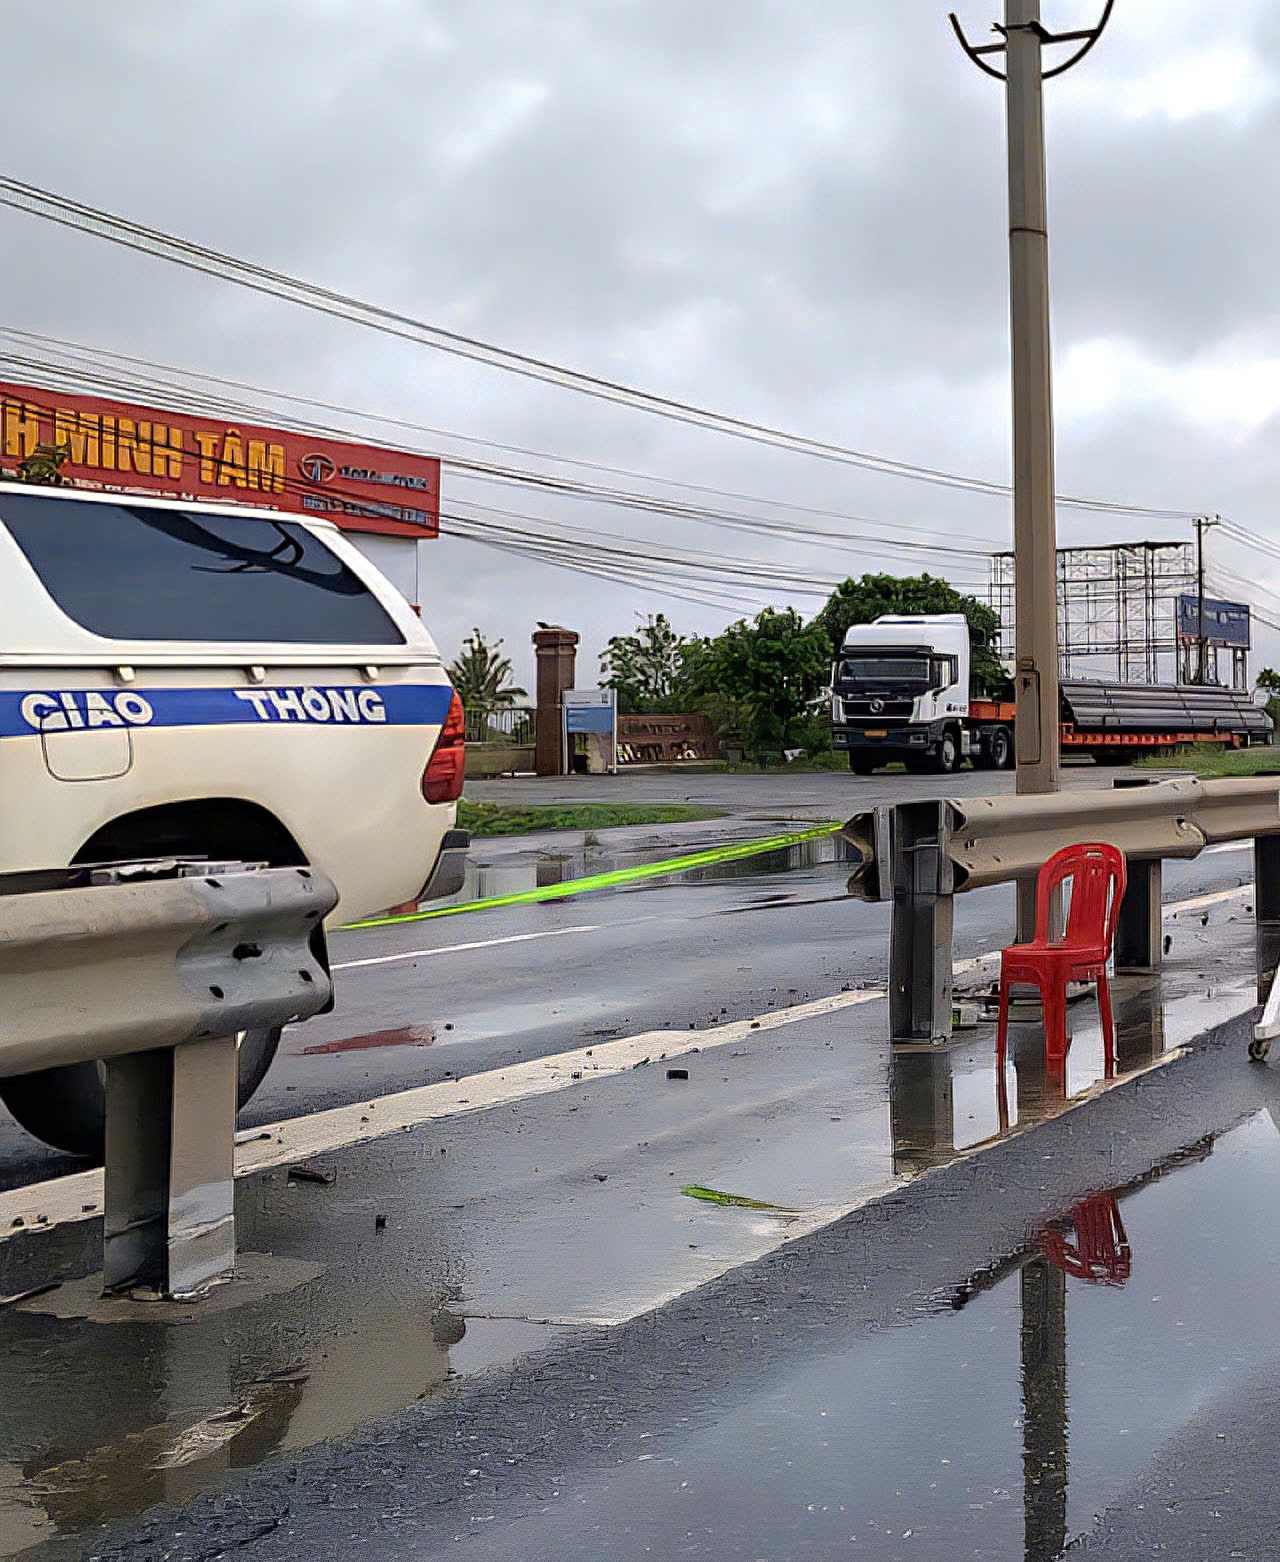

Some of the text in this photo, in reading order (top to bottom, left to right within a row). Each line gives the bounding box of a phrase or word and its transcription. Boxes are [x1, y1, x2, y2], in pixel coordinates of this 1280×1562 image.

[56, 407, 182, 479] MINH
[195, 428, 285, 494] TÂM
[20, 686, 387, 729] GIAO THÔNG
